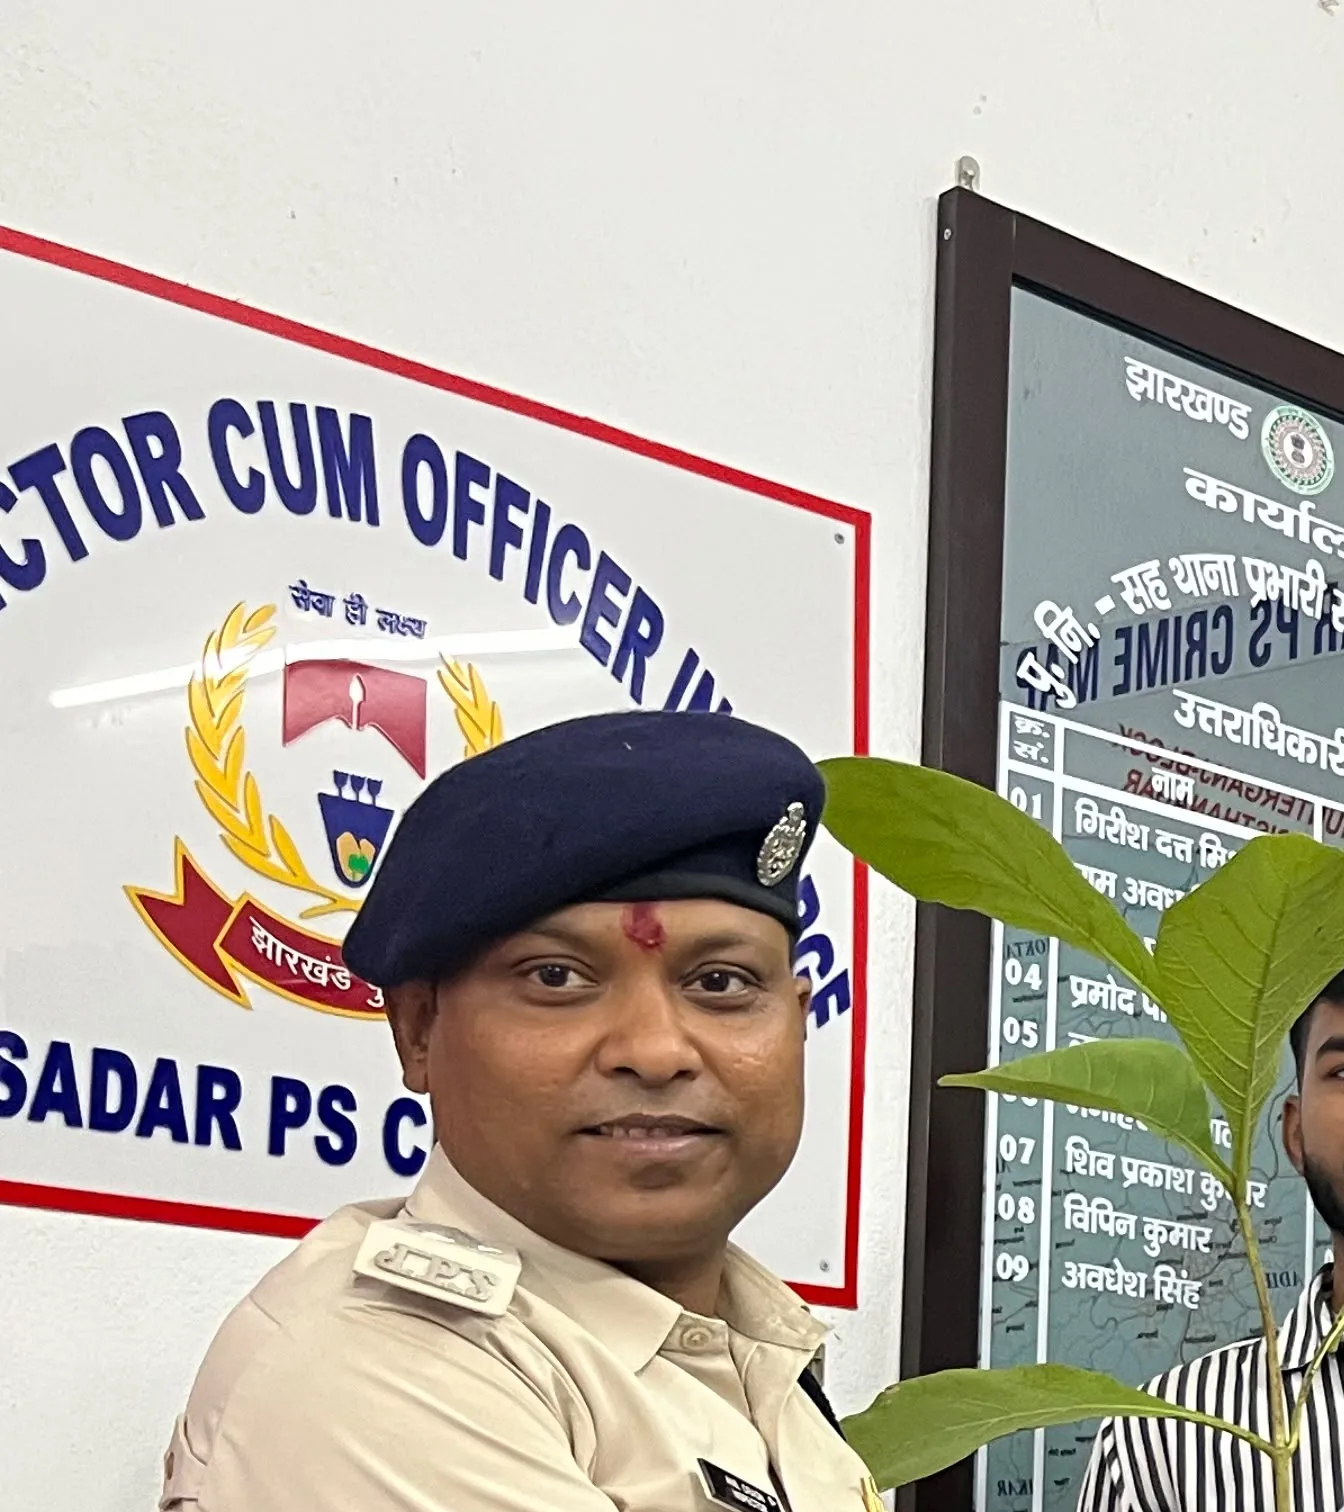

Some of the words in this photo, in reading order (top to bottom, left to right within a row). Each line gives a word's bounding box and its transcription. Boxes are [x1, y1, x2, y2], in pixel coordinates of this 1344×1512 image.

[1124, 356, 1251, 441] झारखण्ड
[0, 411, 206, 592] CTOR
[208, 398, 380, 527] CUM
[402, 433, 664, 705] OFFICER
[1110, 558, 1172, 615] सह
[1169, 553, 1239, 597] थाना
[1241, 556, 1327, 620] प्रभारी
[1151, 766, 1196, 804] नाम
[1010, 787, 1042, 819] 01
[1075, 798, 1149, 850] गिरीश
[250, 915, 351, 990] झारखंड
[1005, 957, 1042, 990] 04
[1069, 973, 1136, 1016] प्रमोद
[1003, 1017, 1039, 1049] 05
[0, 1030, 242, 1151] SADAR
[268, 1076, 357, 1166] PS
[999, 1134, 1035, 1164] 07
[1064, 1135, 1114, 1180] शिव
[1121, 1156, 1195, 1196] प्रकाश
[997, 1193, 1035, 1225] 08
[1063, 1192, 1137, 1240] विपिन
[1143, 1216, 1213, 1257] कुमार
[996, 1252, 1030, 1282] 09
[1062, 1258, 1147, 1299] अवधेश
[1154, 1263, 1202, 1309] सिंह
